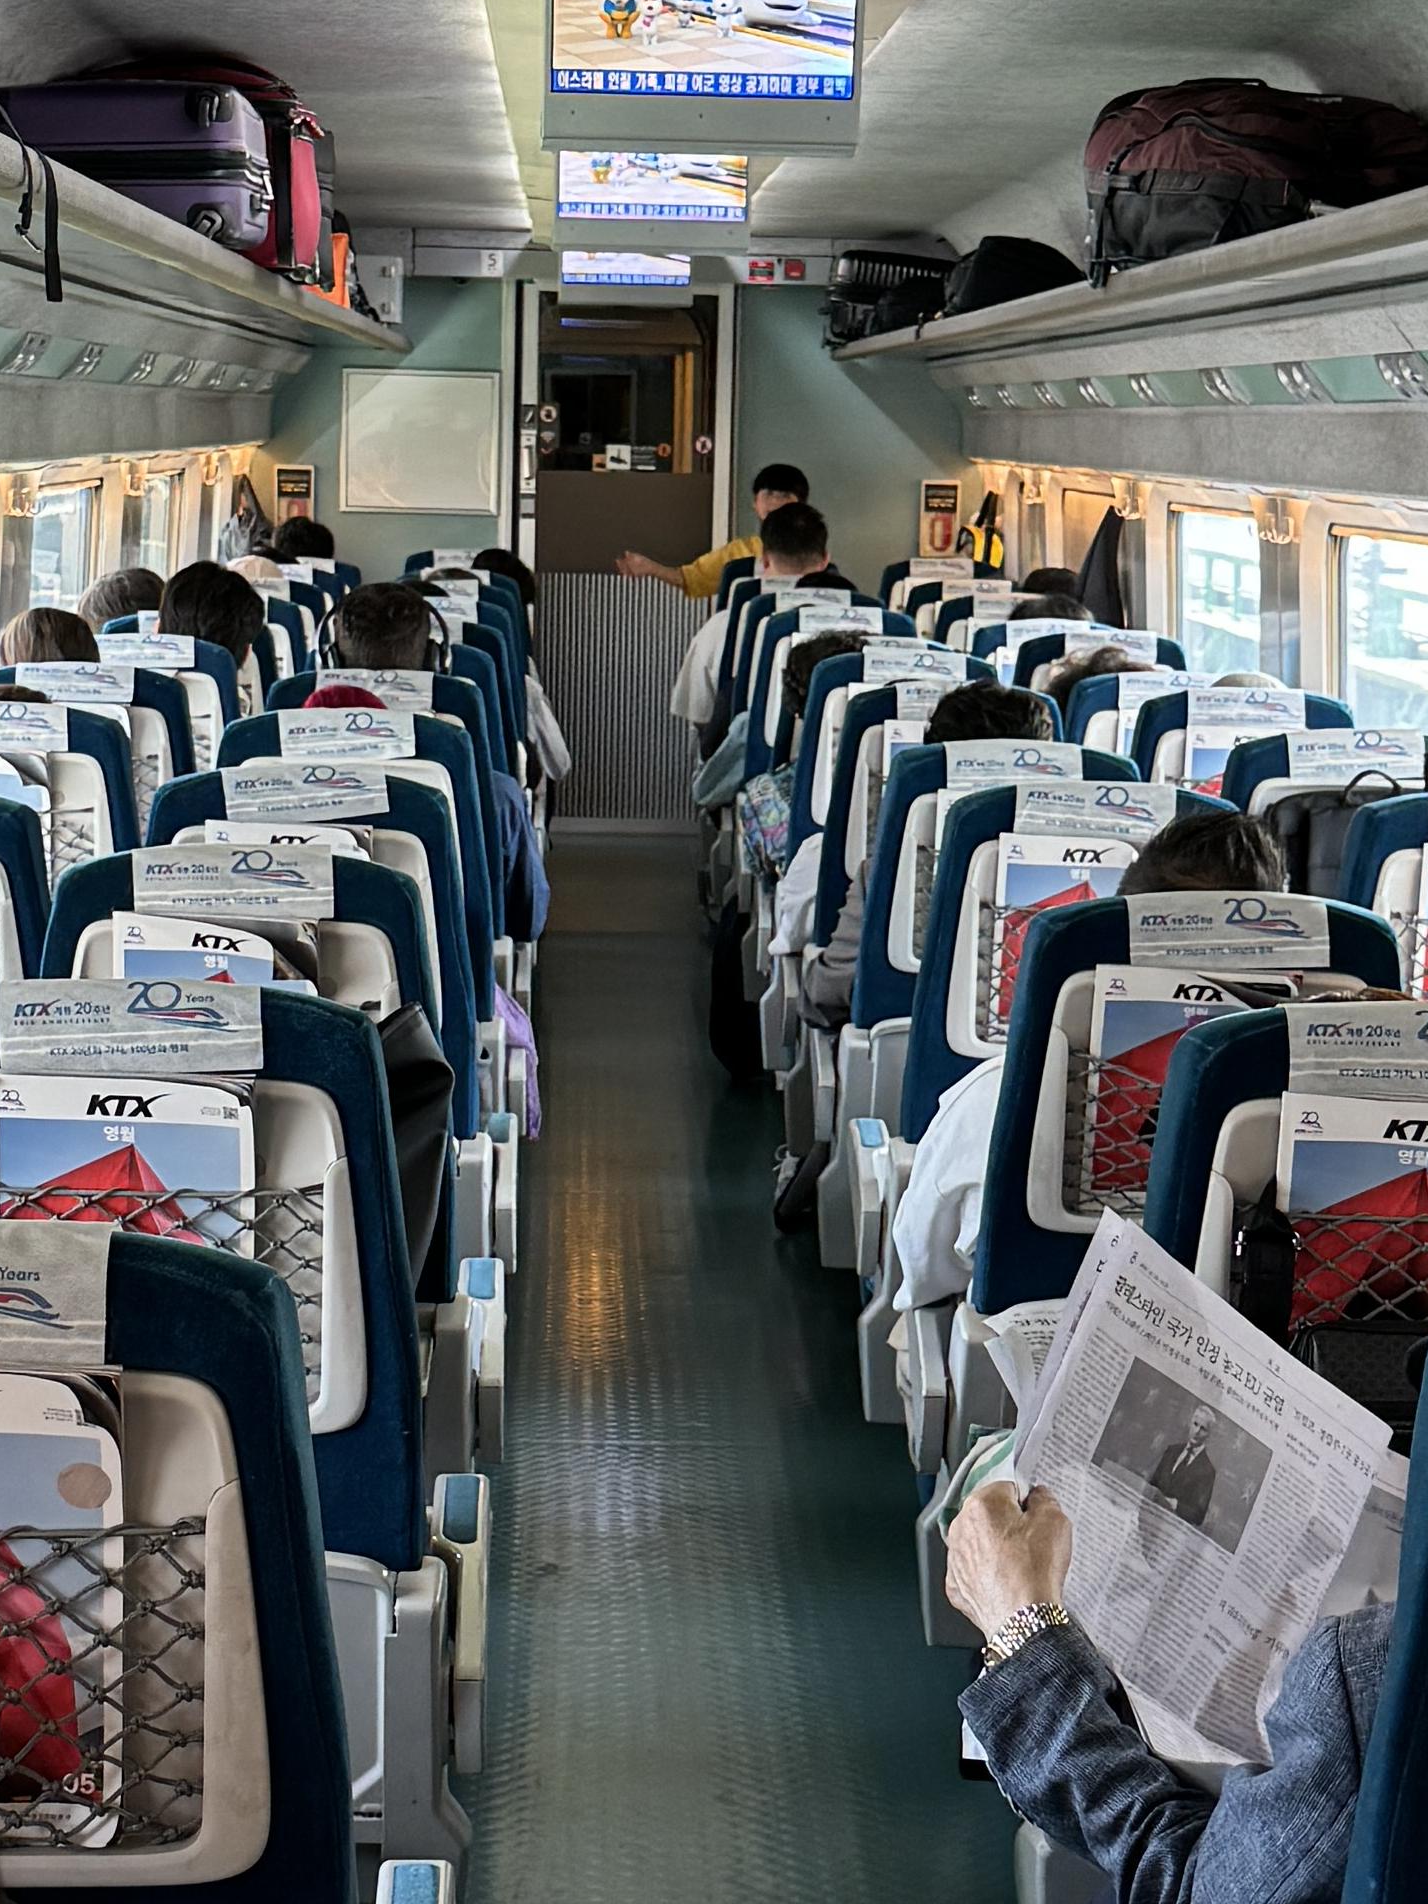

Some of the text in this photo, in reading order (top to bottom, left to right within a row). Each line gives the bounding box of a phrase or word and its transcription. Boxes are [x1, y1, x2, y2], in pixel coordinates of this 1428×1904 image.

[344, 711, 373, 732] 20
[1352, 730, 1383, 749] 20
[1012, 748, 1041, 767] 20
[301, 764, 336, 784] 20
[1095, 785, 1130, 807] 20
[230, 849, 273, 874] 20
[1061, 847, 1115, 864] KTX
[146, 862, 181, 876] KTX
[1223, 897, 1268, 925] 20
[191, 932, 251, 953] KTX
[127, 981, 216, 1014] 20 Years
[1172, 983, 1225, 1003] KTX
[13, 999, 61, 1019] KTX
[1306, 1020, 1353, 1039] KTX
[85, 1092, 171, 1119] KTX
[102, 1124, 136, 1144] 영월
